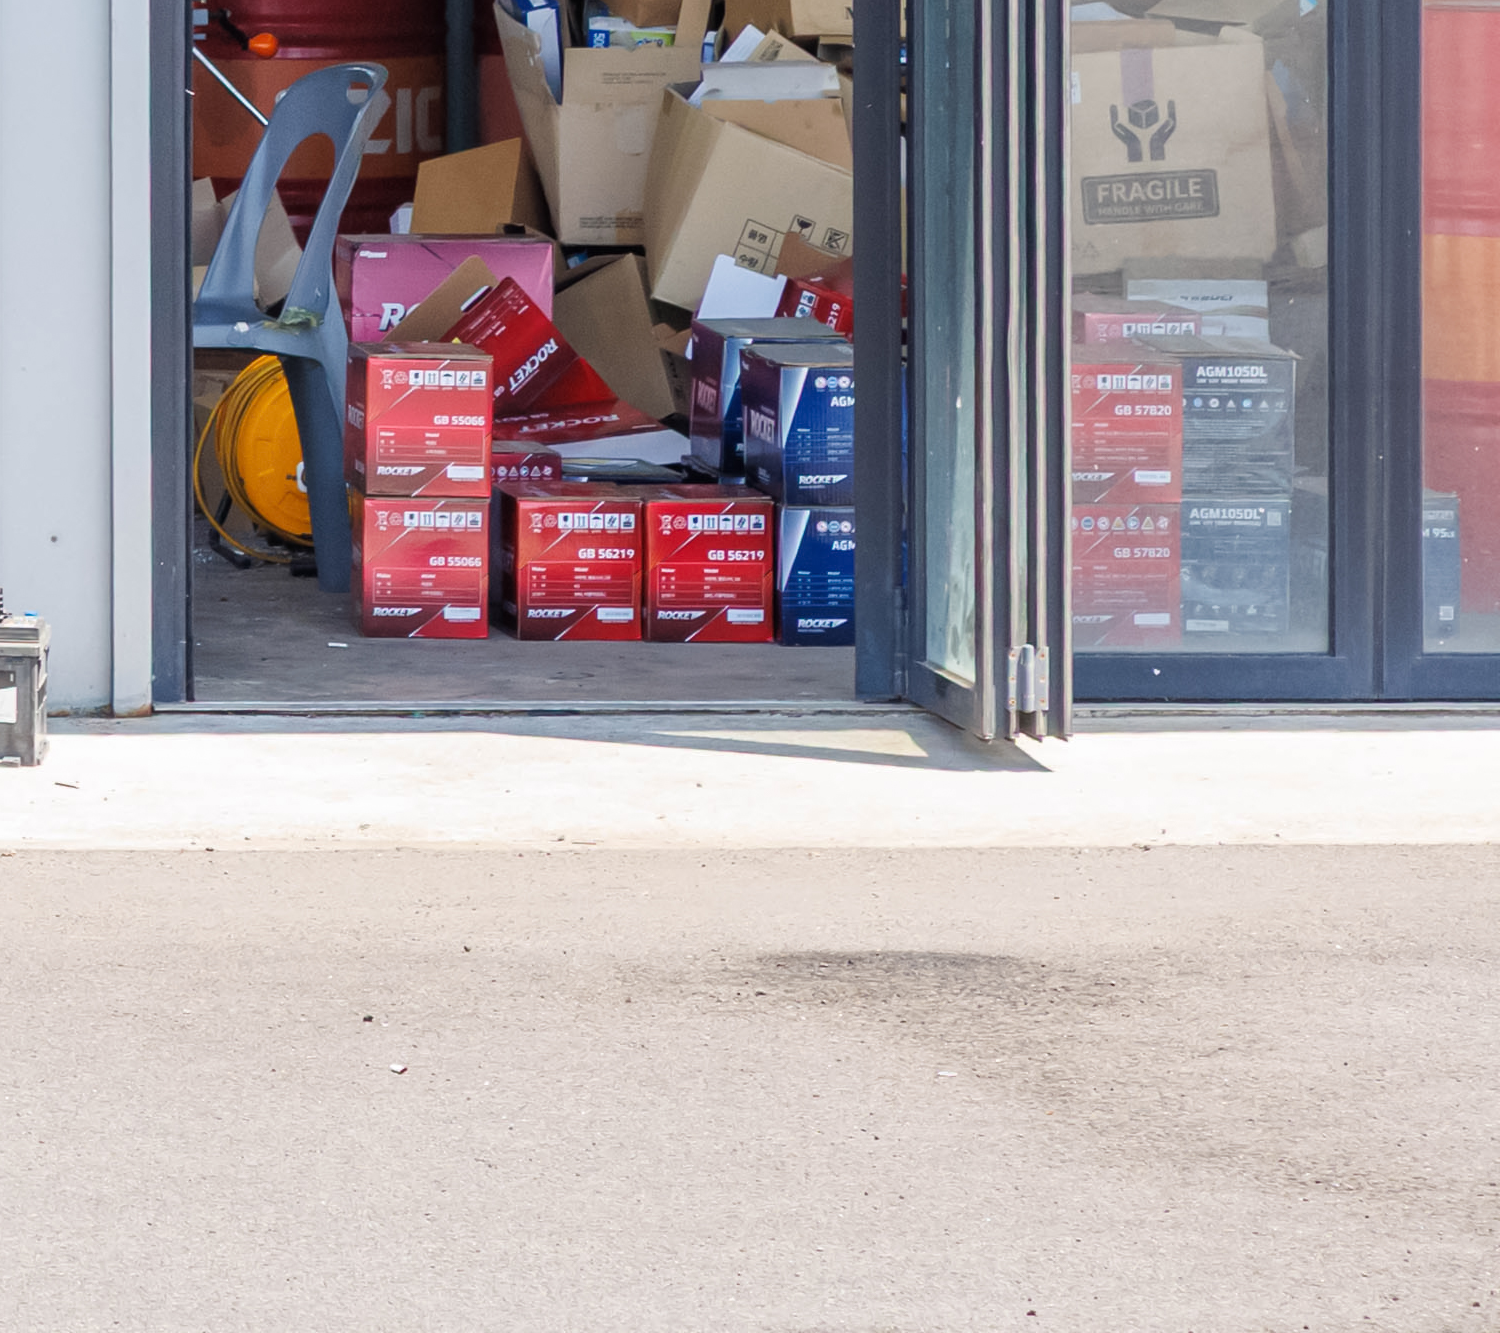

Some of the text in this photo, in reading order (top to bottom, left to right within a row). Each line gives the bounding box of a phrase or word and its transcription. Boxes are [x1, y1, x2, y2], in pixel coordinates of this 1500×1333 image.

[1098, 178, 1204, 204] FRAGILE
[508, 337, 560, 392] ROCKET
[1115, 405, 1132, 415] GB
[434, 415, 449, 425] GB
[519, 414, 620, 433] ROCKET
[799, 474, 847, 484] ROCKET
[1190, 507, 1261, 520] AGM105DL
[578, 548, 635, 559] GB 56219
[707, 550, 765, 560] GB 56219
[1114, 547, 1131, 558] GB
[429, 556, 482, 567] GB 55066
[527, 609, 576, 618] ROCKET
[657, 611, 706, 620] ROCKET
[798, 619, 848, 628] ROCKET
